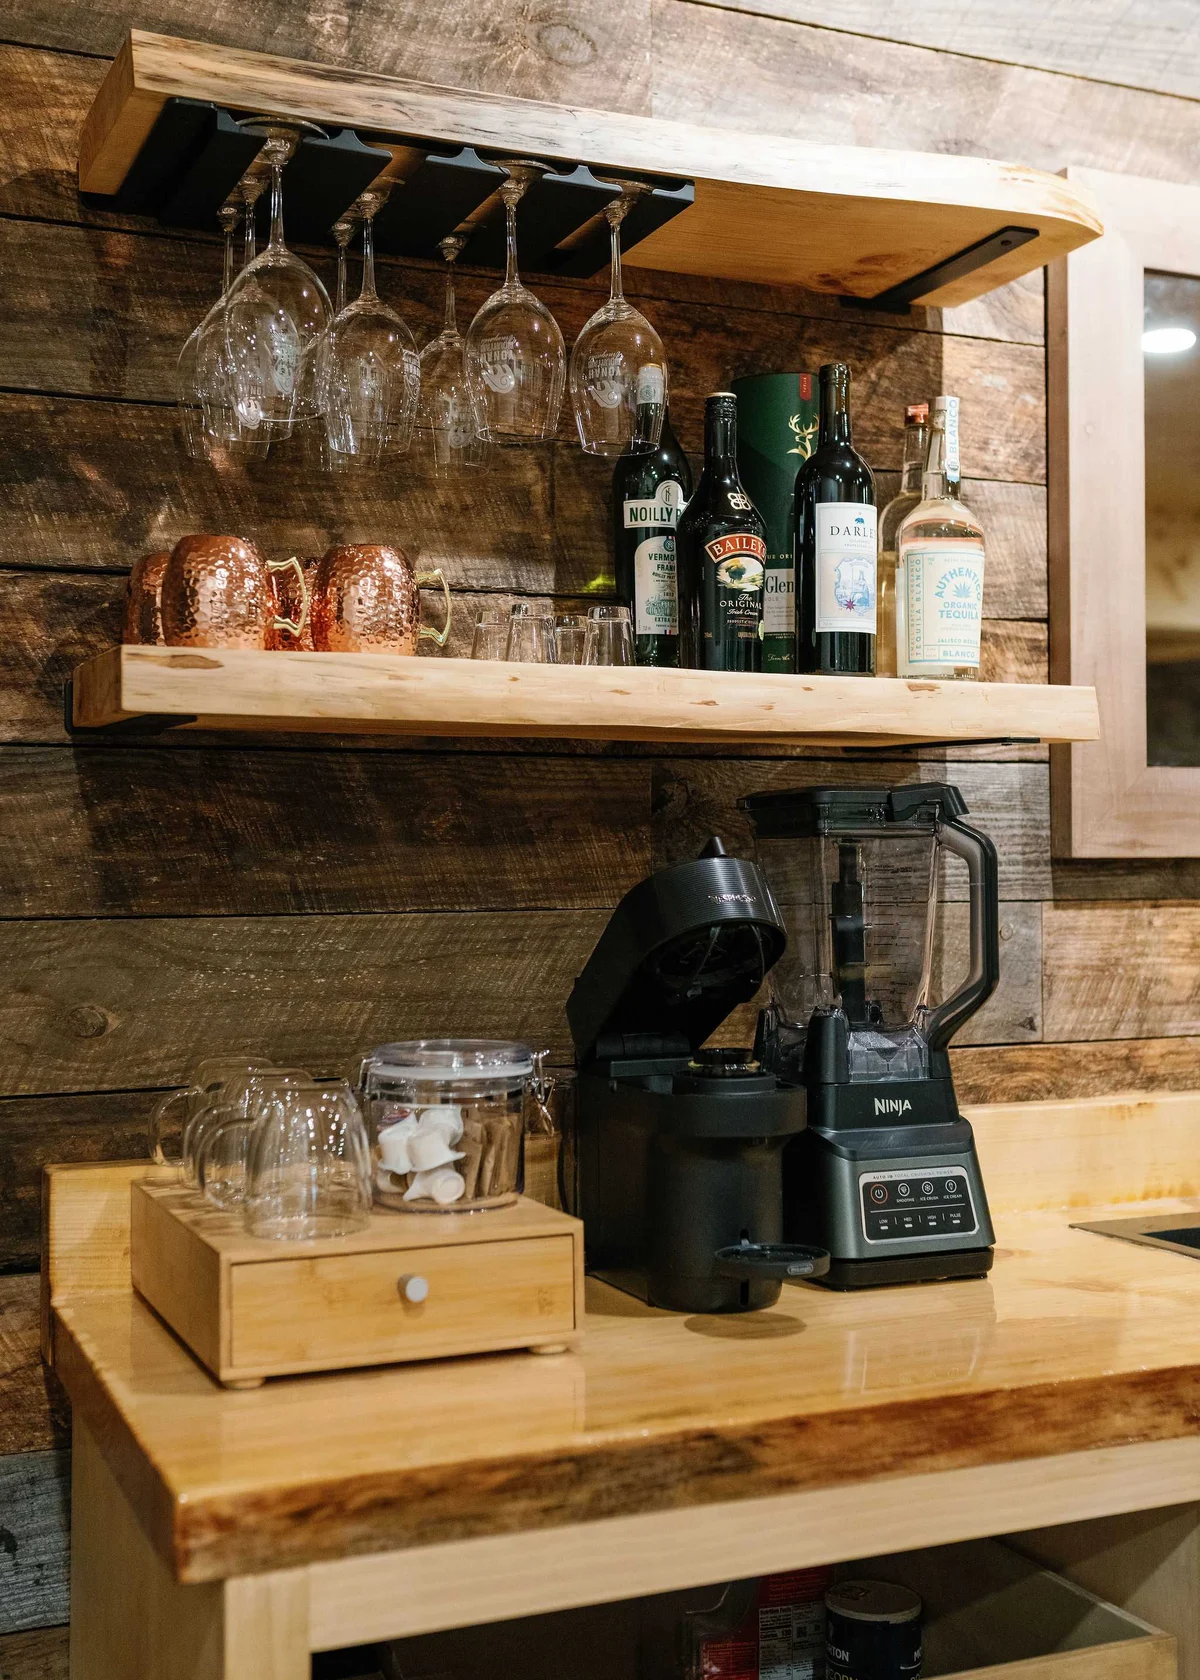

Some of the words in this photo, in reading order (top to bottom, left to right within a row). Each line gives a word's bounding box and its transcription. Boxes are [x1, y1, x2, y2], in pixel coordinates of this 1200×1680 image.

[588, 366, 620, 379] YONAH
[949, 400, 957, 454] BLANCO
[629, 507, 673, 523] NOILLY
[765, 576, 794, 594] Glen
[934, 567, 982, 601] AUTHENTICO
[738, 593, 753, 601] The
[719, 600, 762, 610] ORIGINAL
[943, 601, 978, 611] ORGANIC
[938, 610, 979, 620] TEQUILA
[942, 650, 975, 658] BLANCO
[874, 1097, 912, 1117] NINJA
